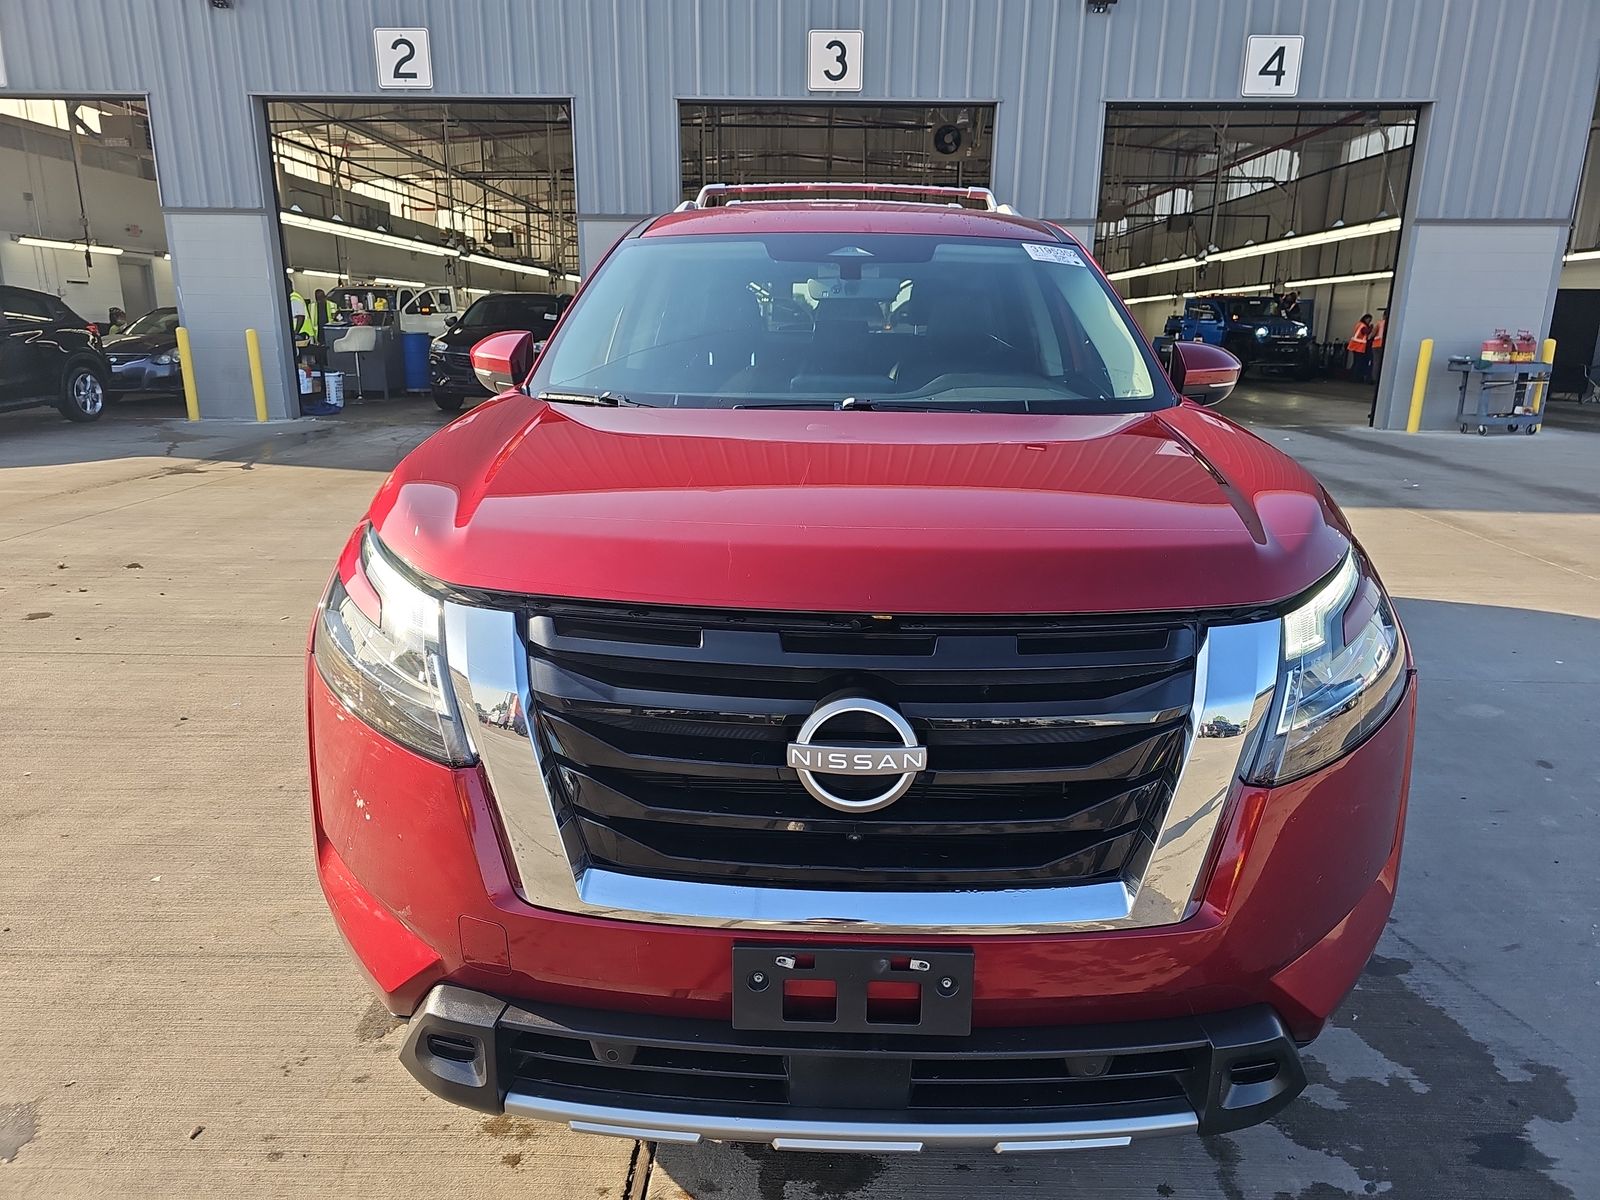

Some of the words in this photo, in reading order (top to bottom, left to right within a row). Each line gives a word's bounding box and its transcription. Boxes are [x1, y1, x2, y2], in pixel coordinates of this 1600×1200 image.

[391, 38, 417, 79] 2
[823, 40, 848, 81] 3
[1258, 46, 1286, 86] 4
[791, 749, 922, 770] NISSAN
